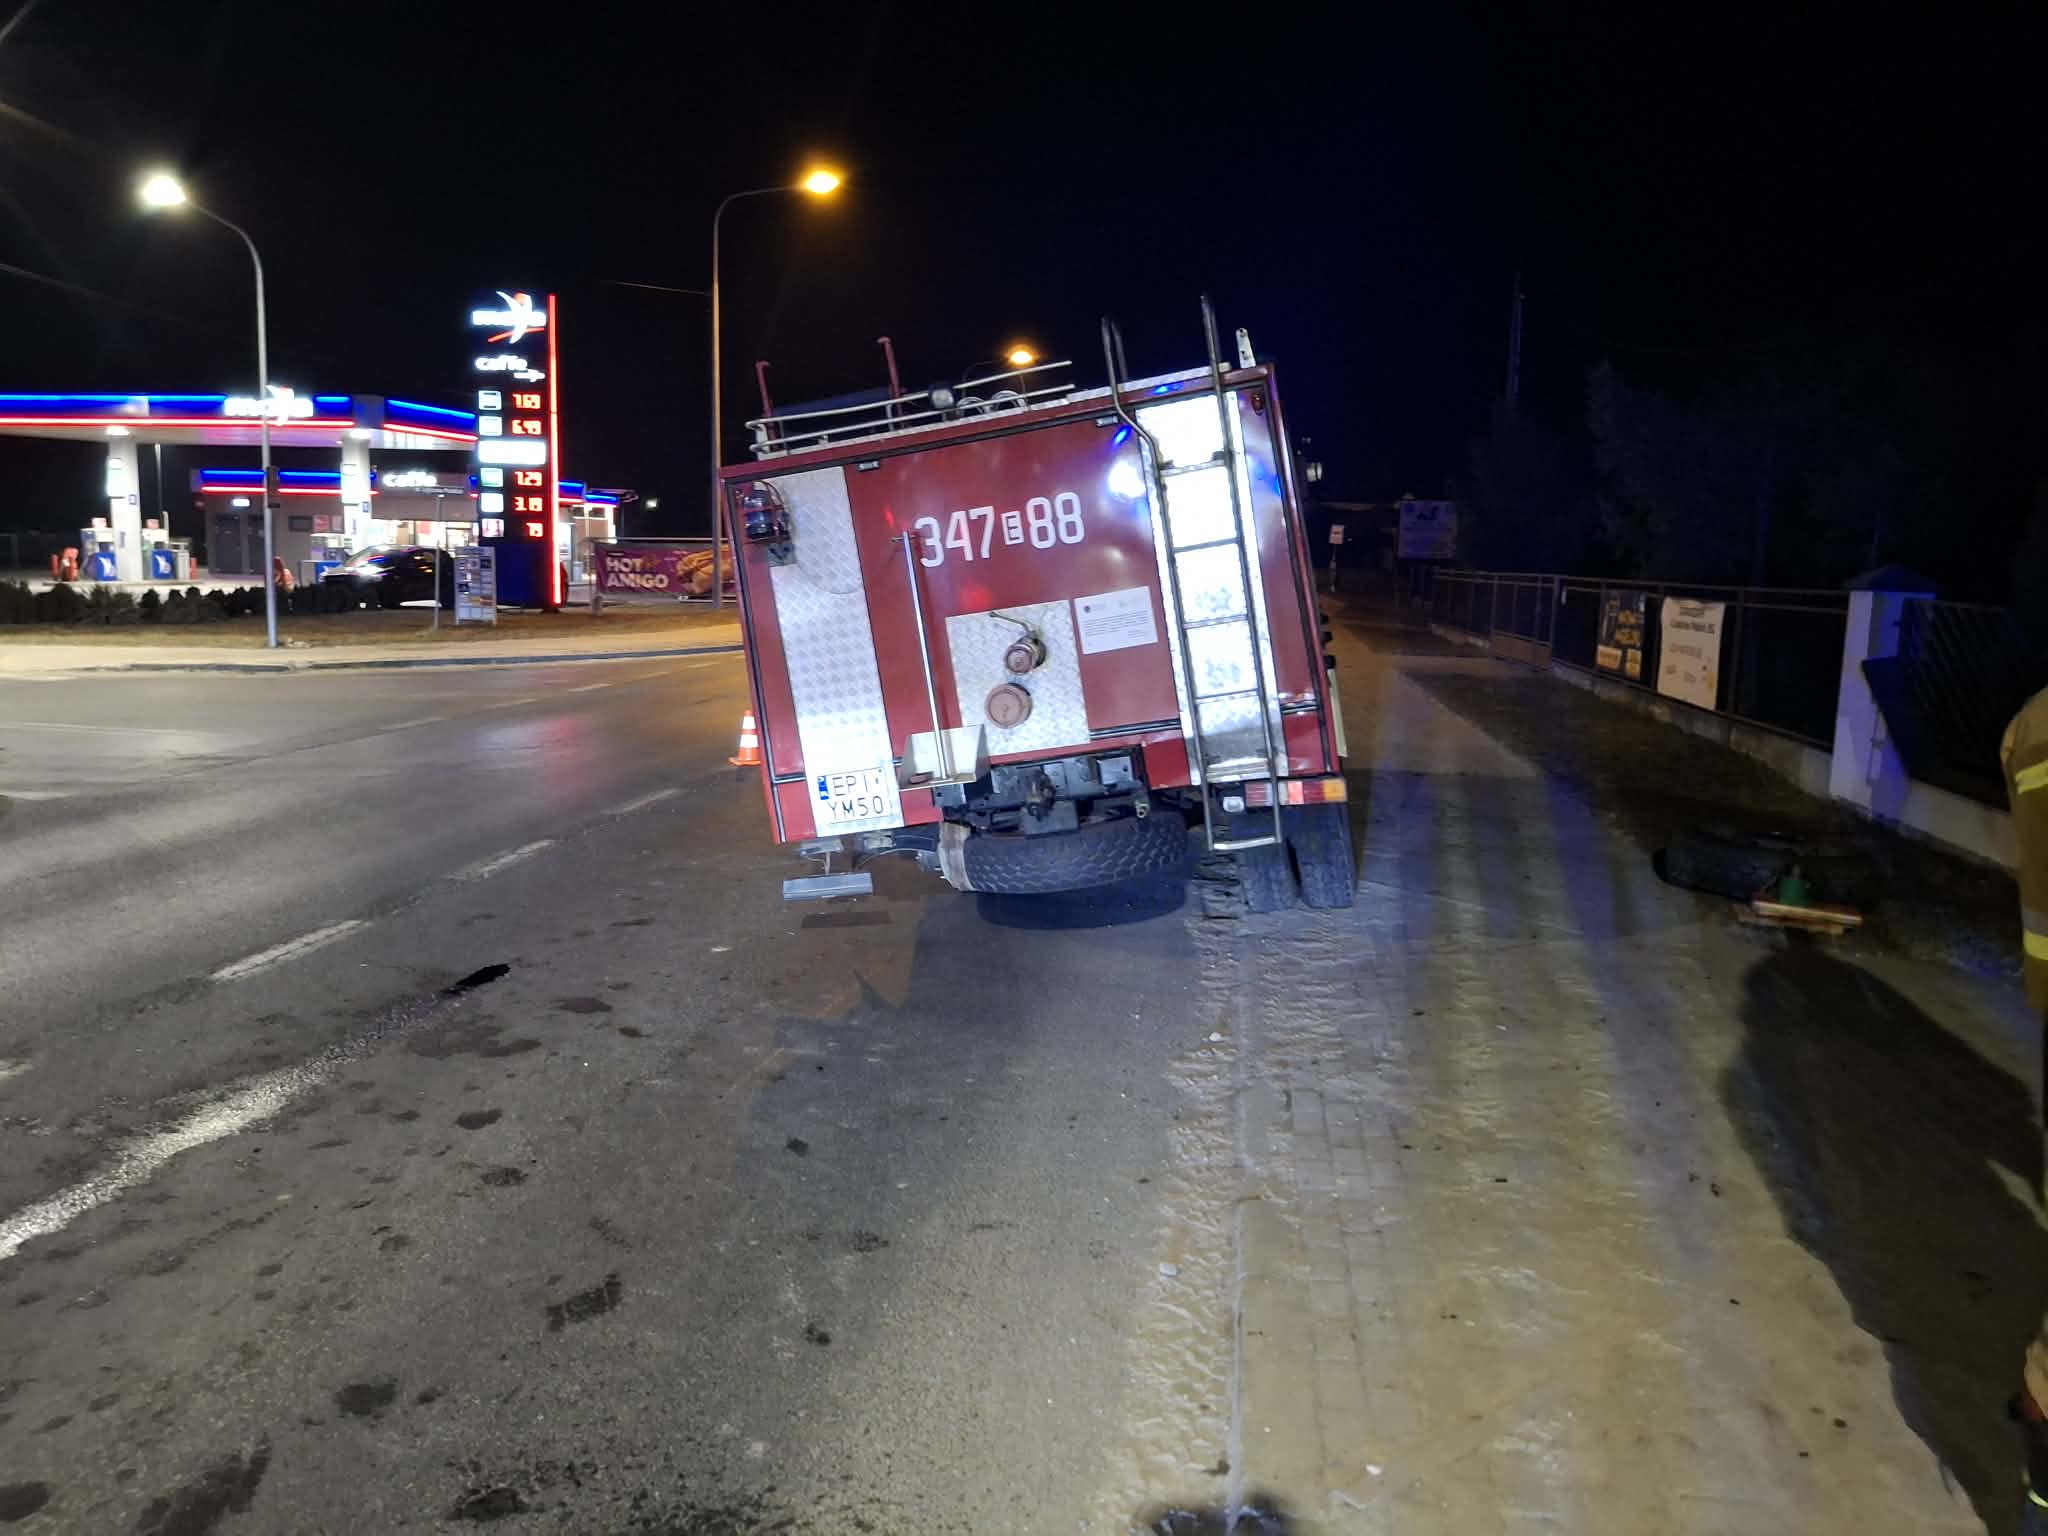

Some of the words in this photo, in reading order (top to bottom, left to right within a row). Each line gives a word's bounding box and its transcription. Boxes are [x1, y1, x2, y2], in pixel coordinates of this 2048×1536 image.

[605, 556, 643, 573] HOT
[607, 572, 669, 589] AMIGO
[827, 795, 884, 819] YM50
